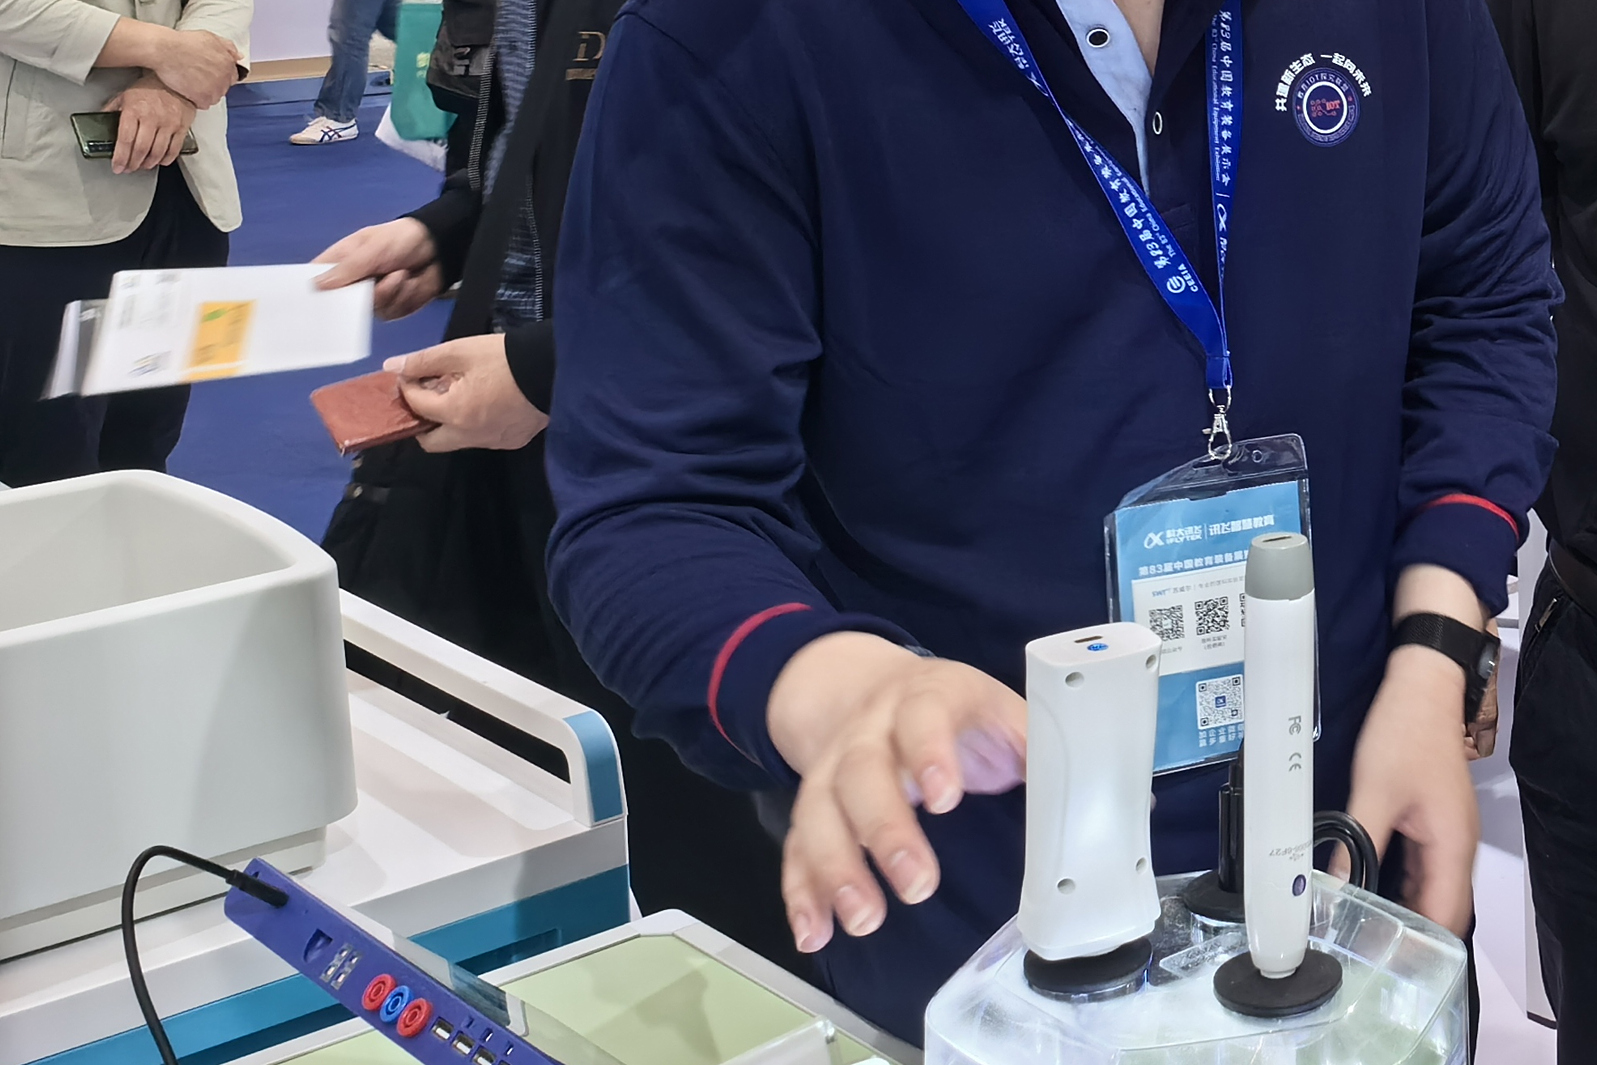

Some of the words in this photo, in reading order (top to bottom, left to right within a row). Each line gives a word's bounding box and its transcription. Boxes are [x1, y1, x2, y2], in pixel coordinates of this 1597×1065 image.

[1177, 262, 1199, 293] CEEIA
[1209, 514, 1275, 536] 讯飞智慧教育
